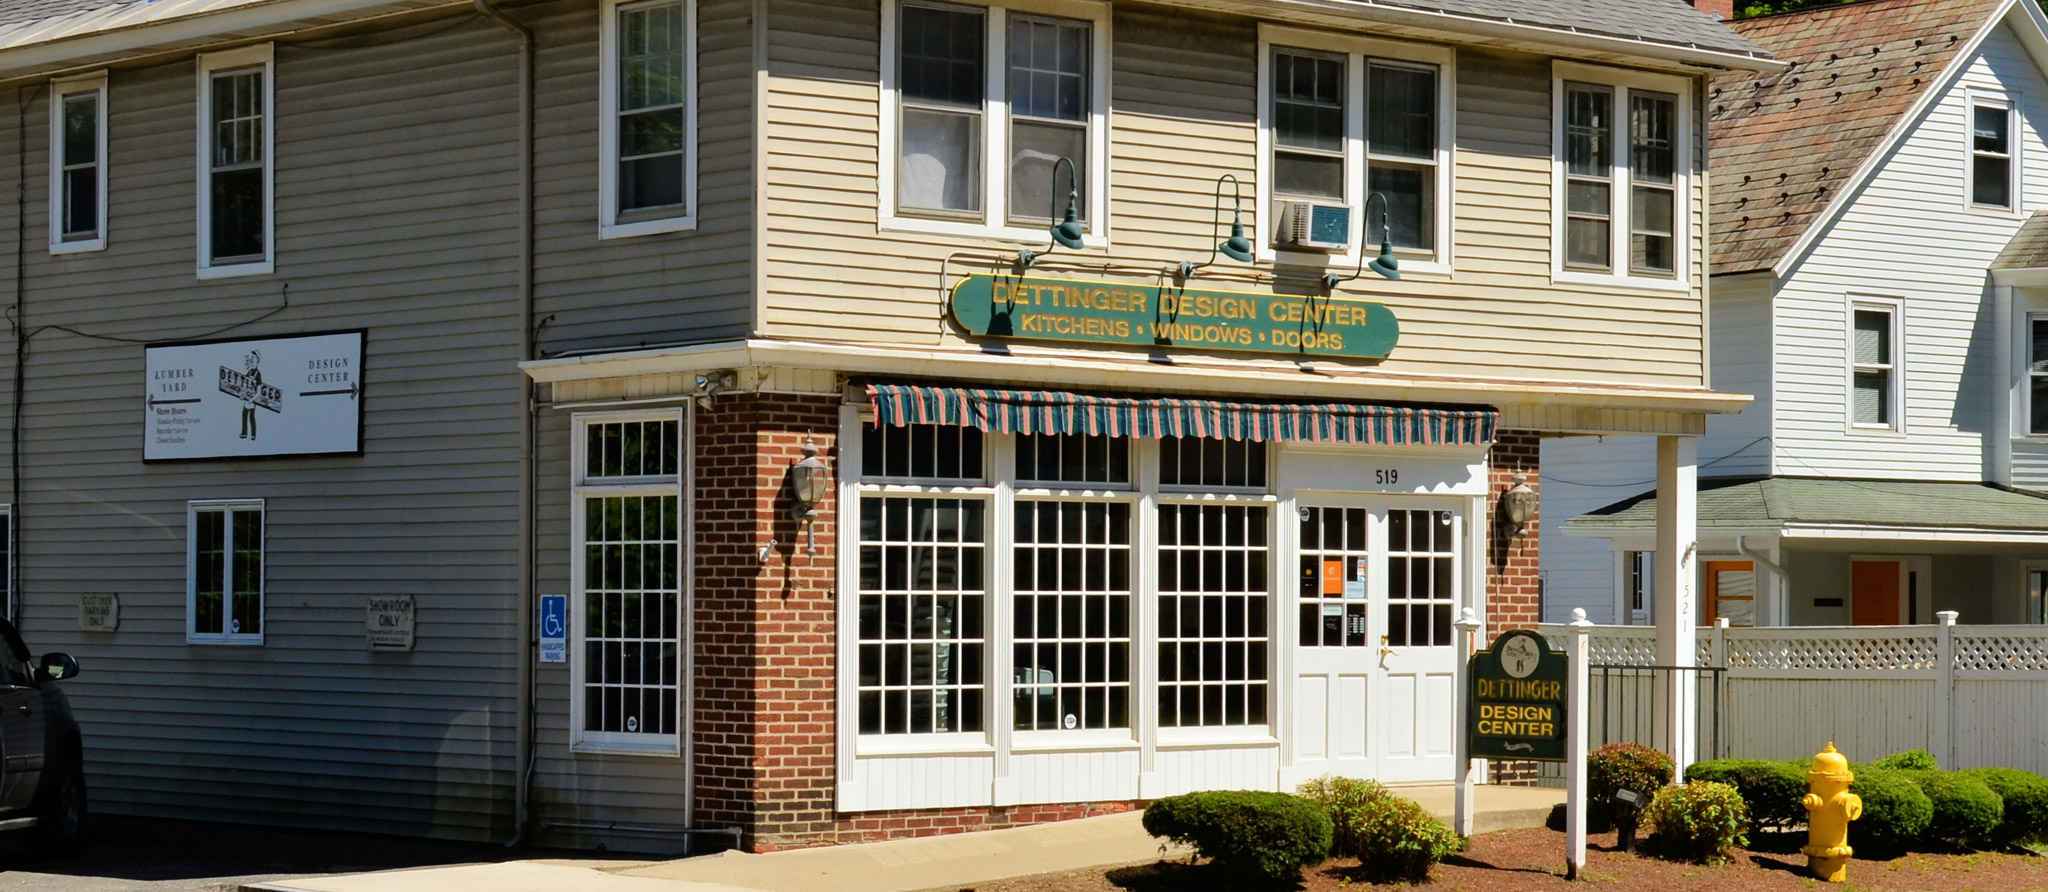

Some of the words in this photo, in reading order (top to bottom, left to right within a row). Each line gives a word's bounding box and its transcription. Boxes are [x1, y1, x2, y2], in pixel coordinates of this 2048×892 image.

[993, 282, 1147, 313] DETTINGER
[1159, 293, 1257, 319] DESIGN
[1268, 301, 1367, 327] CENTER
[1021, 313, 1131, 337] KITCHENS
[1150, 322, 1253, 345] WINDOWS
[1271, 329, 1344, 351] DOORS
[308, 357, 349, 370] DESIGN
[154, 368, 194, 380] LUMBER
[307, 371, 349, 384] CENTER
[161, 381, 188, 393] YARD
[1375, 469, 1398, 485] 519
[369, 599, 412, 612] SHOWROOM
[379, 614, 401, 627] ONLY
[1478, 678, 1561, 700] DETTINGER
[1480, 705, 1553, 721] DESIGN
[1478, 720, 1554, 736] CENTER
